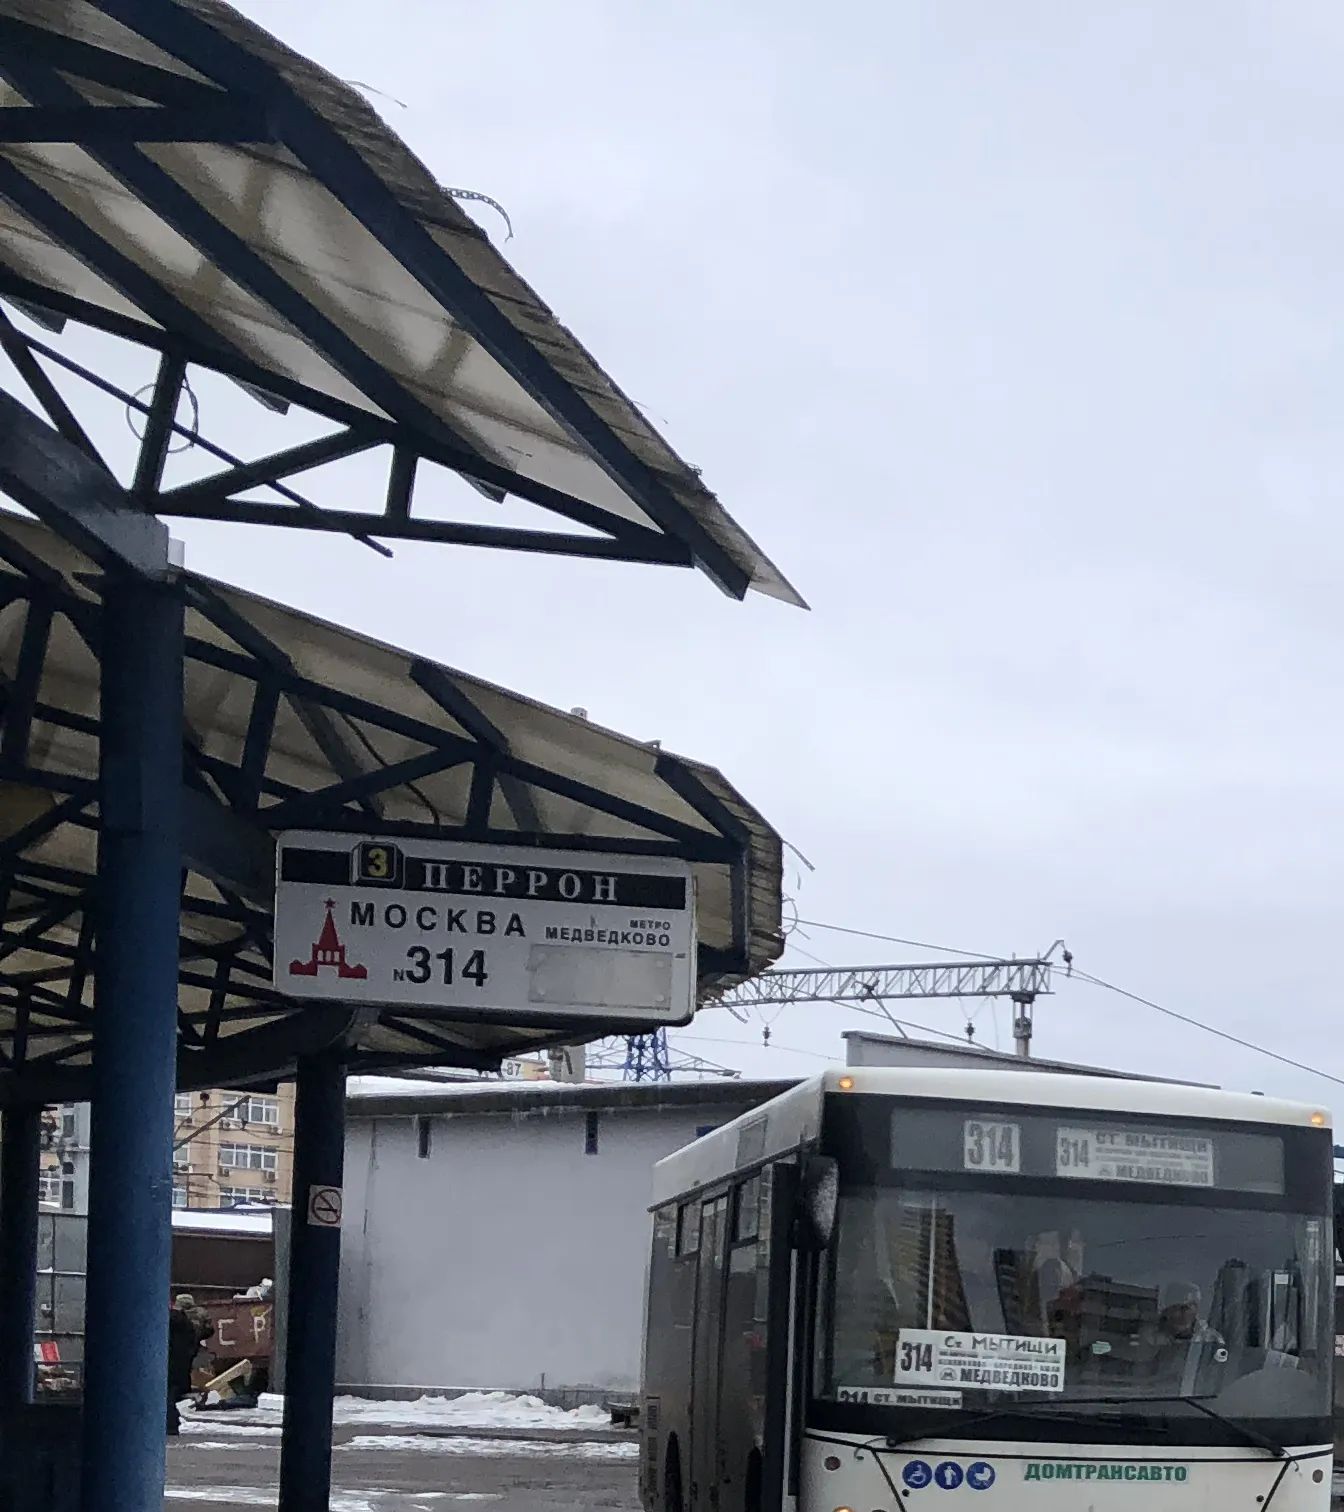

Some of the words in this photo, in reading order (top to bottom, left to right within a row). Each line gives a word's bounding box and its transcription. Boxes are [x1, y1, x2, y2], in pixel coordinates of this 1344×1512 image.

[367, 847, 388, 877] 3
[422, 861, 619, 901] ПЕРРОН
[349, 901, 527, 938] МОСКВА
[629, 918, 671, 932] МЕТРО
[544, 925, 671, 948] МЕДВЕДКОВО
[968, 1122, 1015, 1167] 314
[1059, 1137, 1089, 1168] 314
[900, 1341, 933, 1372] 314
[972, 1336, 1057, 1355] МЫТИЩИ
[960, 1368, 1059, 1388] МЕДВЕДКОВО
[1024, 1463, 1187, 1481] ДОМТРАНСАВТО
